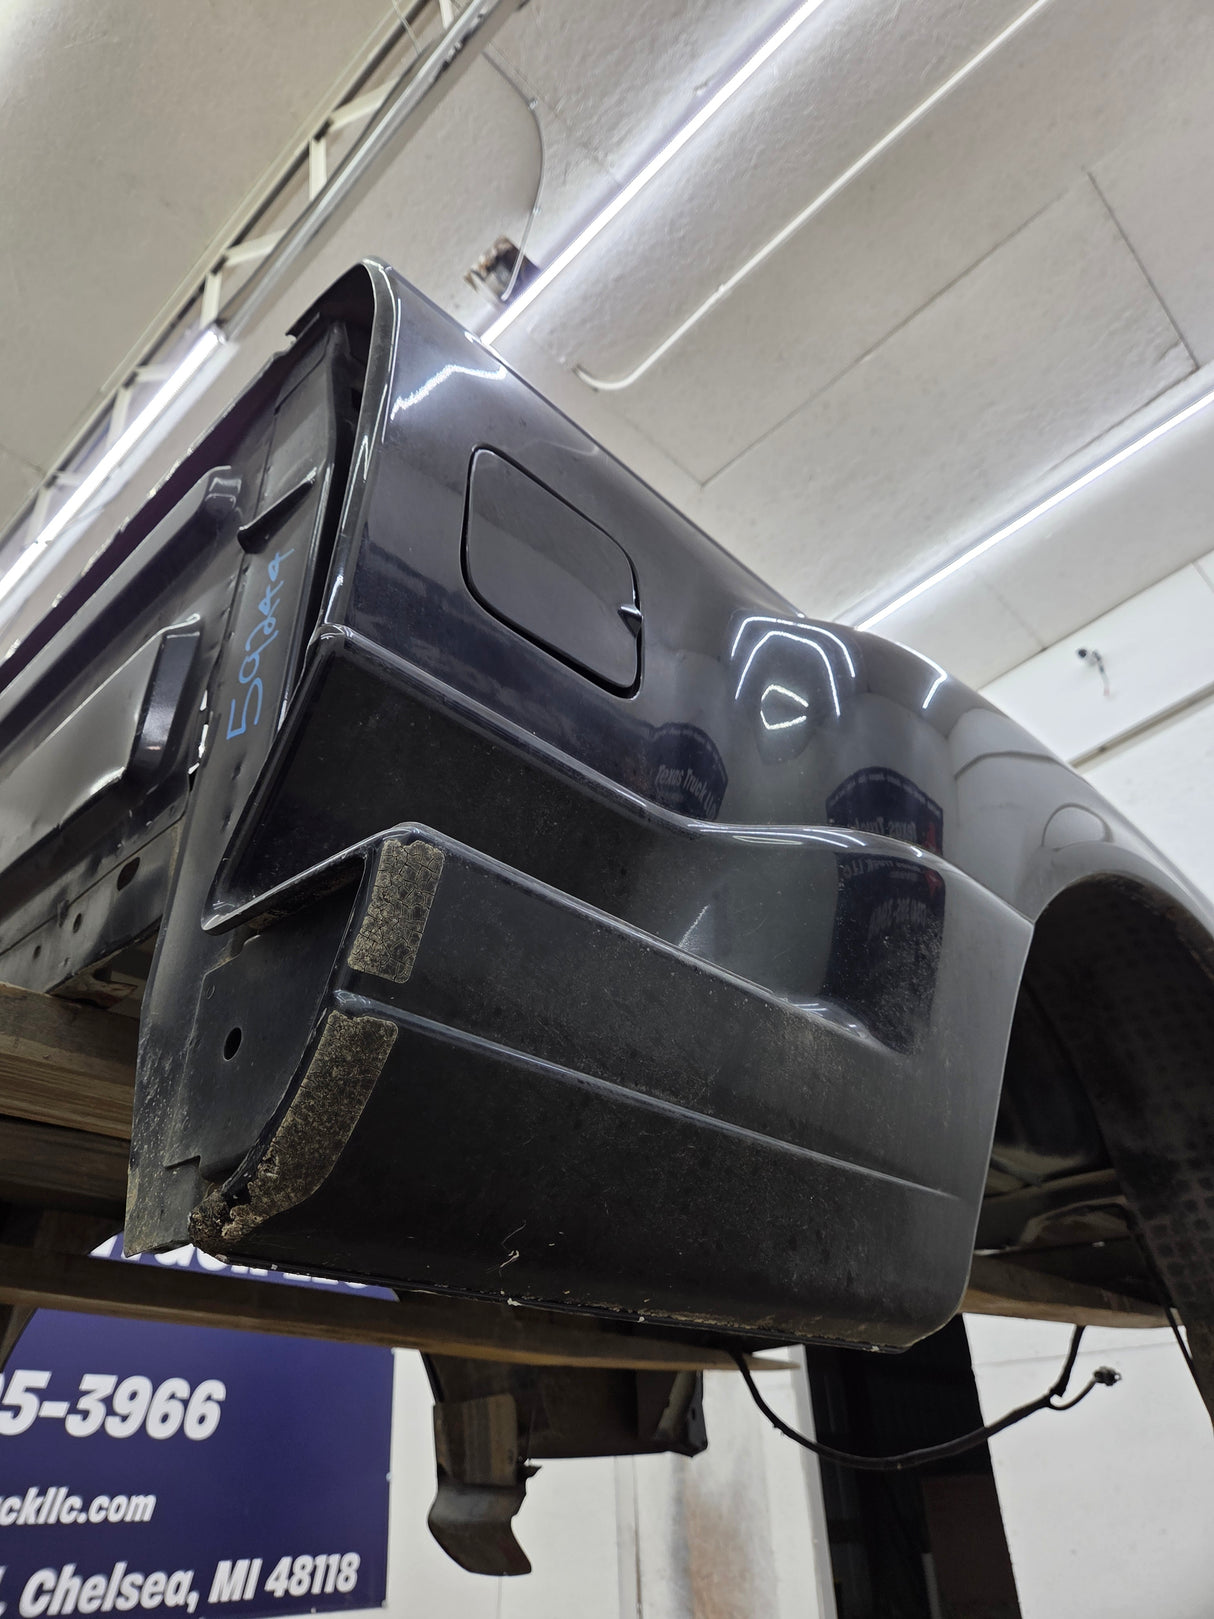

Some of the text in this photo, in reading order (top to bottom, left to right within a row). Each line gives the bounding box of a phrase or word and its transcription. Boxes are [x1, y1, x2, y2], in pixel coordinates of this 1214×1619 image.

[0, 1369, 226, 1441] 5-3966
[0, 1486, 156, 1526] ckllc.com
[18, 1561, 199, 1618] Chelsea,
[208, 1557, 263, 1604] MI
[264, 1552, 361, 1598] 48118
